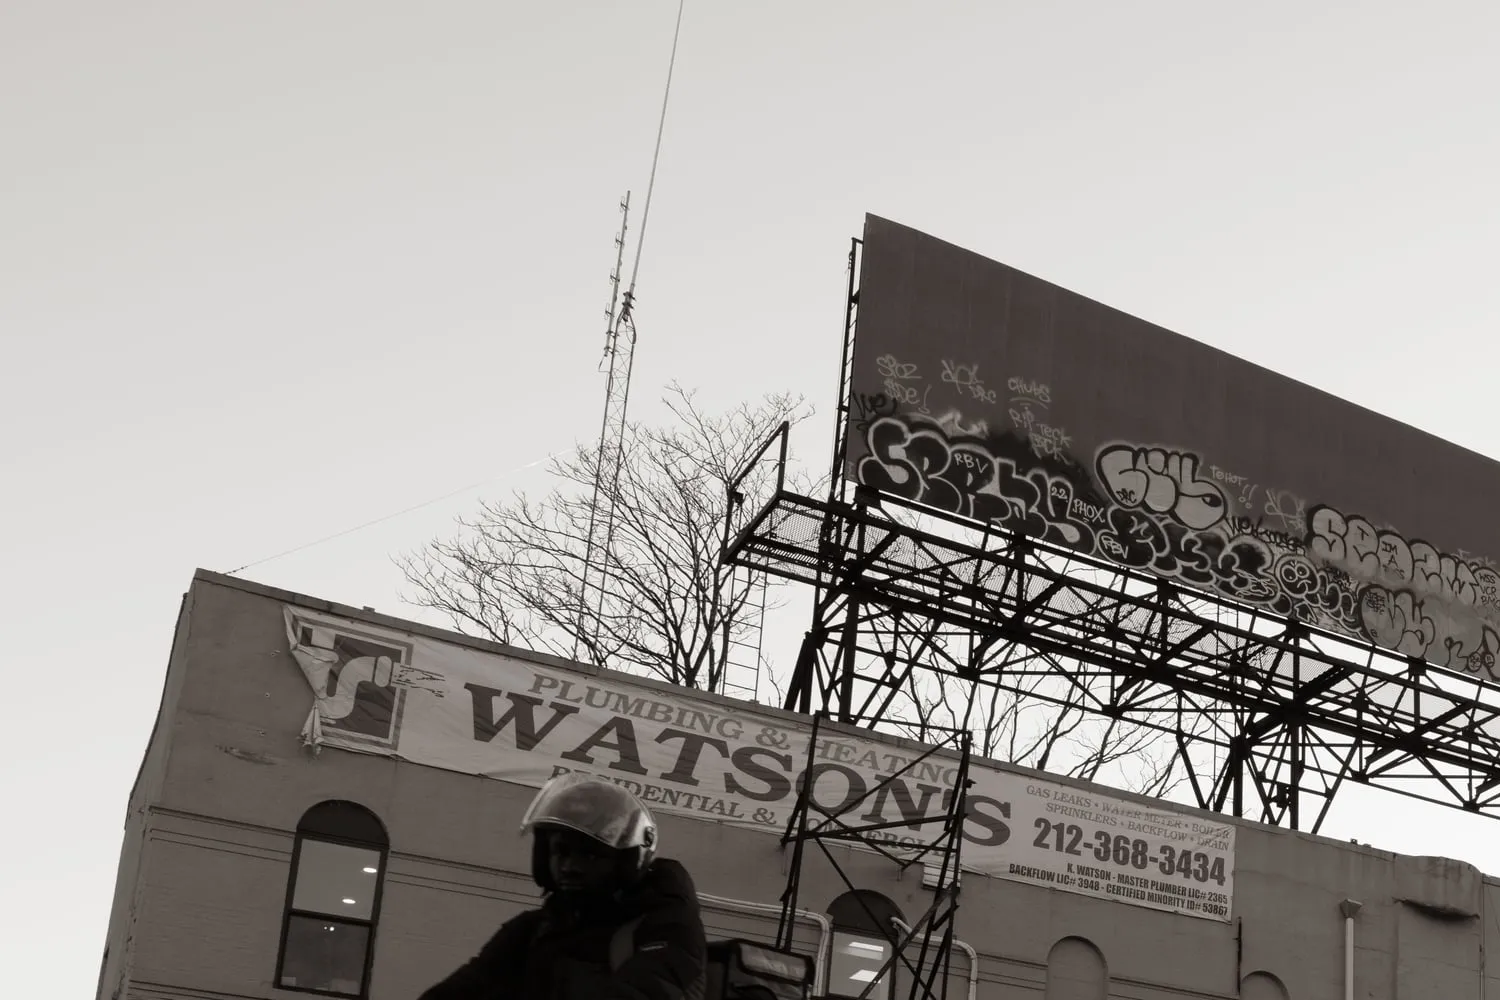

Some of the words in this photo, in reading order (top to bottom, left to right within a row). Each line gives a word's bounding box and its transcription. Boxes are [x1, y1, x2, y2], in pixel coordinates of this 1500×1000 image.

[528, 673, 744, 740] PLUMBING
[755, 725, 791, 750] &
[464, 682, 1011, 847] WATSON'S
[752, 807, 777, 825] &
[1026, 785, 1051, 799] GAS
[1053, 791, 1092, 808] LEAKS
[1033, 817, 1226, 886] 212-368-3434
[1046, 803, 1117, 827] SPRINKLERS
[1128, 821, 1187, 842] BACKFLOW
[1196, 835, 1230, 850] DRAIN
[1009, 863, 1055, 882] BACKFLOW
[1057, 873, 1076, 886] LIC#
[1078, 877, 1099, 891] 3948
[1106, 884, 1145, 900] CERTIFIED
[1147, 892, 1185, 909] MINORITY
[1186, 900, 1201, 910] ID#
[1202, 901, 1228, 916] 53867
[1067, 863, 1076, 873] K.
[1077, 864, 1111, 881] WATSON
[1117, 873, 1149, 888] MASTER
[1151, 880, 1186, 897] PLUMBER
[1188, 887, 1206, 899] LIC#
[1208, 891, 1228, 904] 2365
